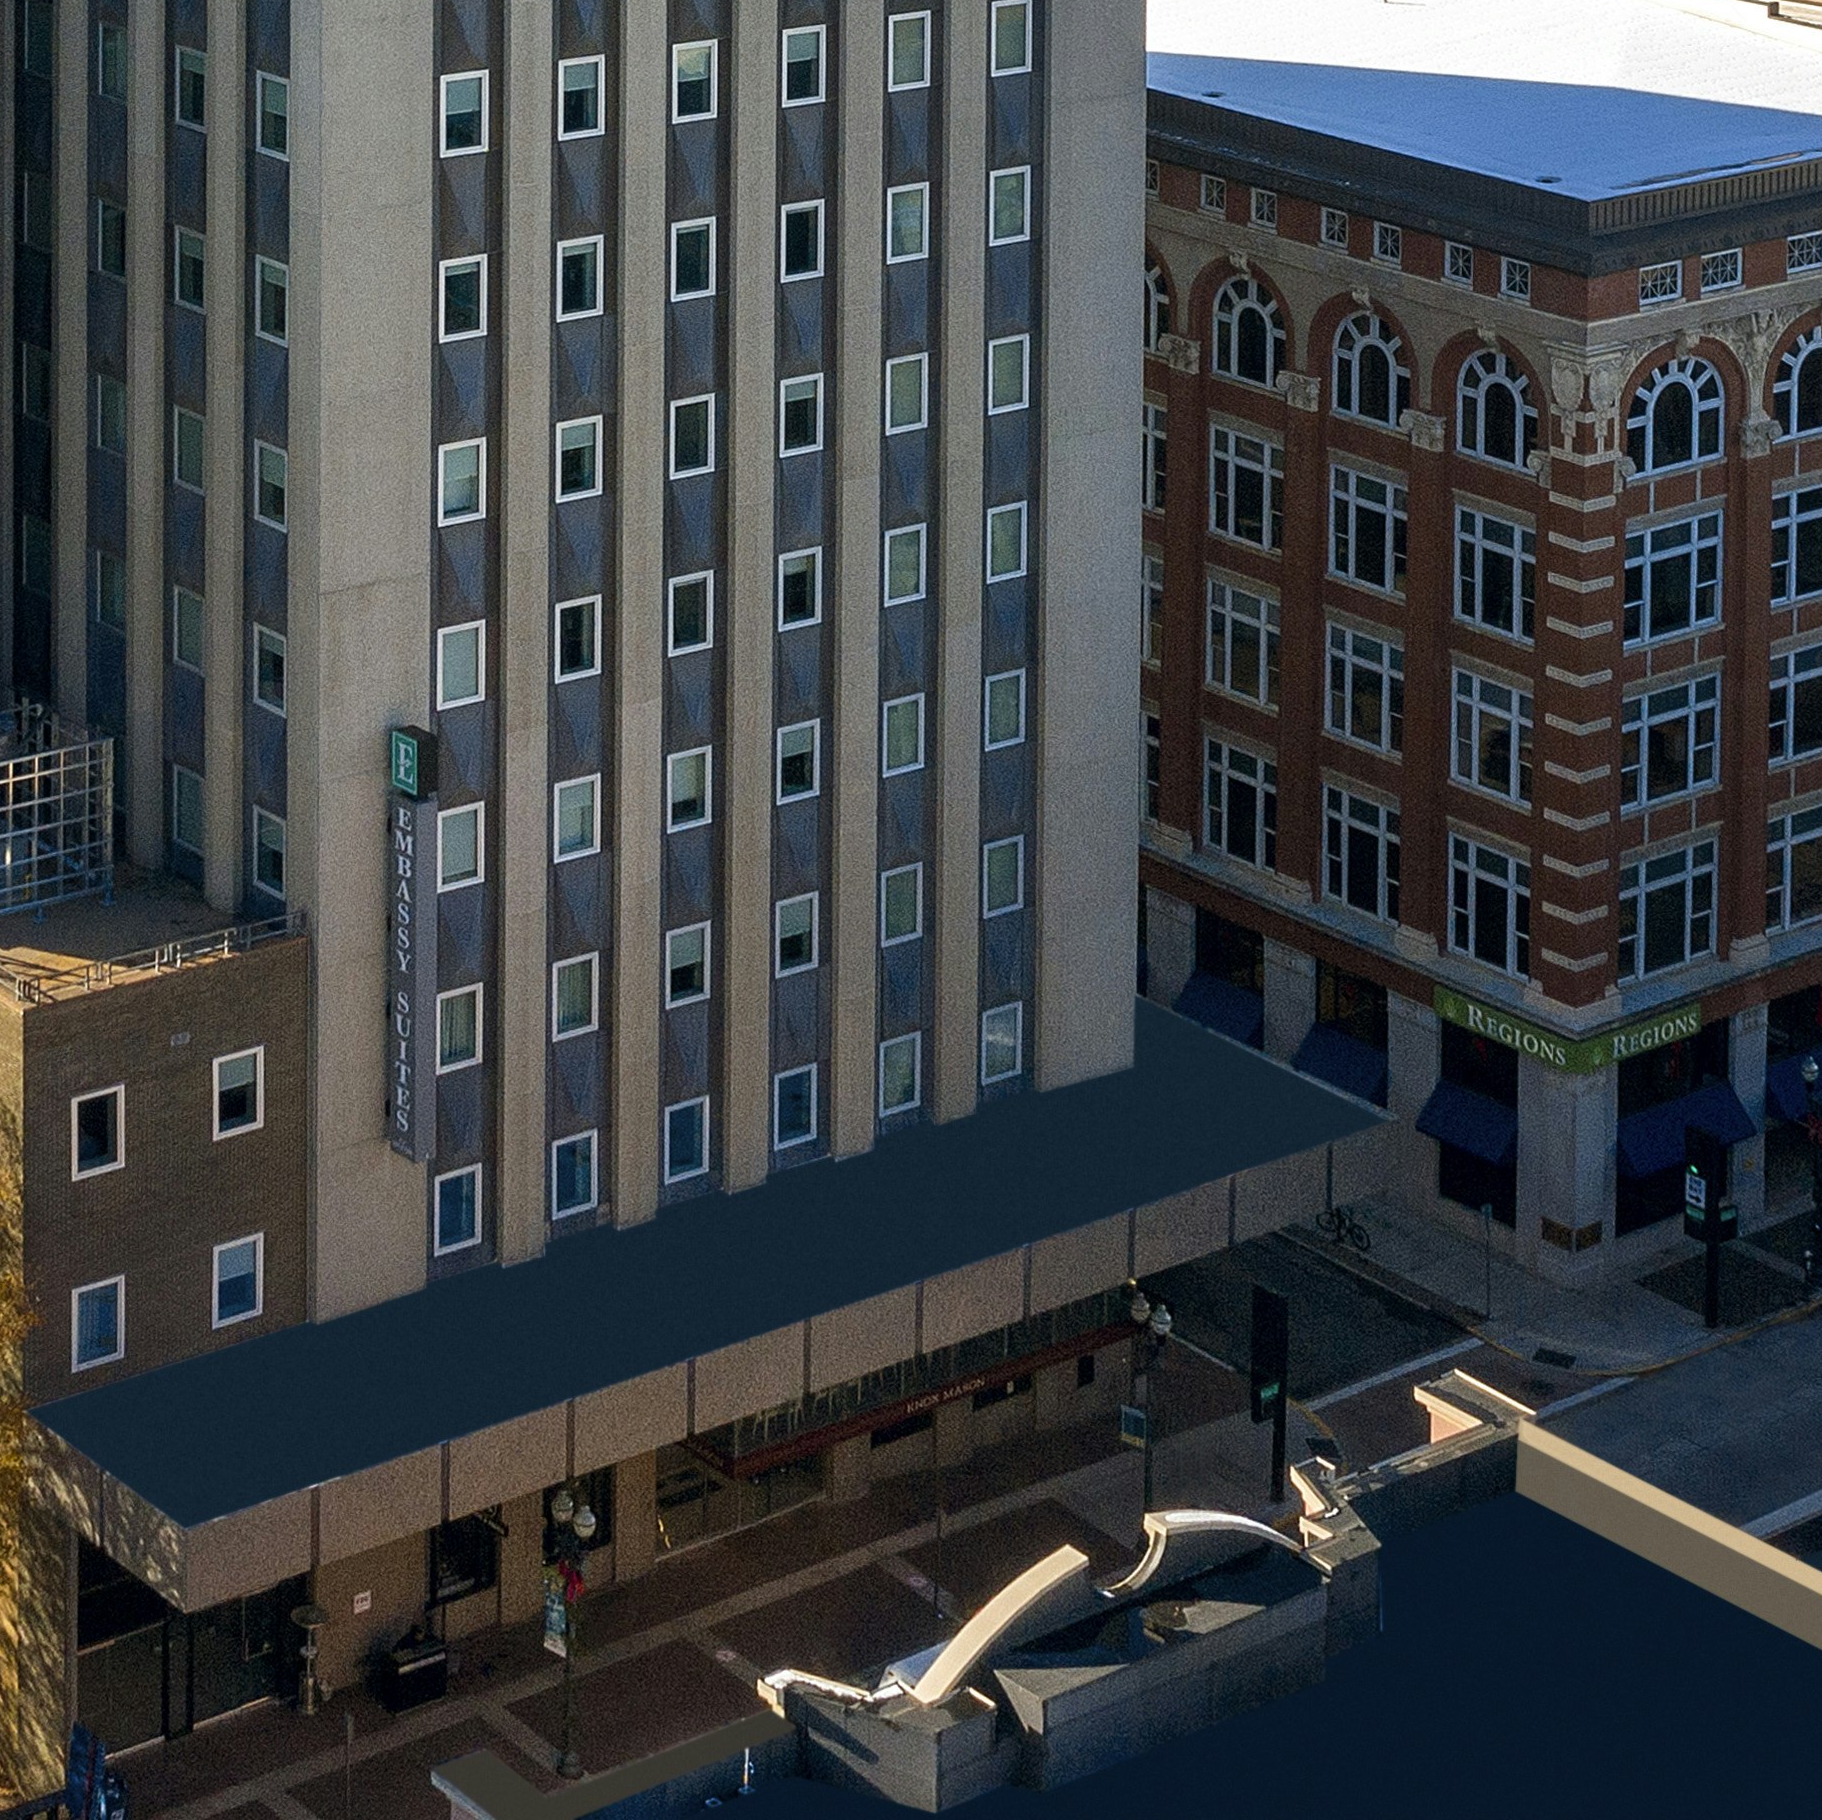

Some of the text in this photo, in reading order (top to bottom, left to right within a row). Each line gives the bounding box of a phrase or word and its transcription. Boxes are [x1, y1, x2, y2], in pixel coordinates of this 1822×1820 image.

[395, 807, 414, 973] EMBASSY
[395, 992, 413, 1133] SUITES
[1467, 1005, 1566, 1066] REGIONS
[1612, 1012, 1698, 1058] REGIONS
[906, 1394, 939, 1414] KNOX
